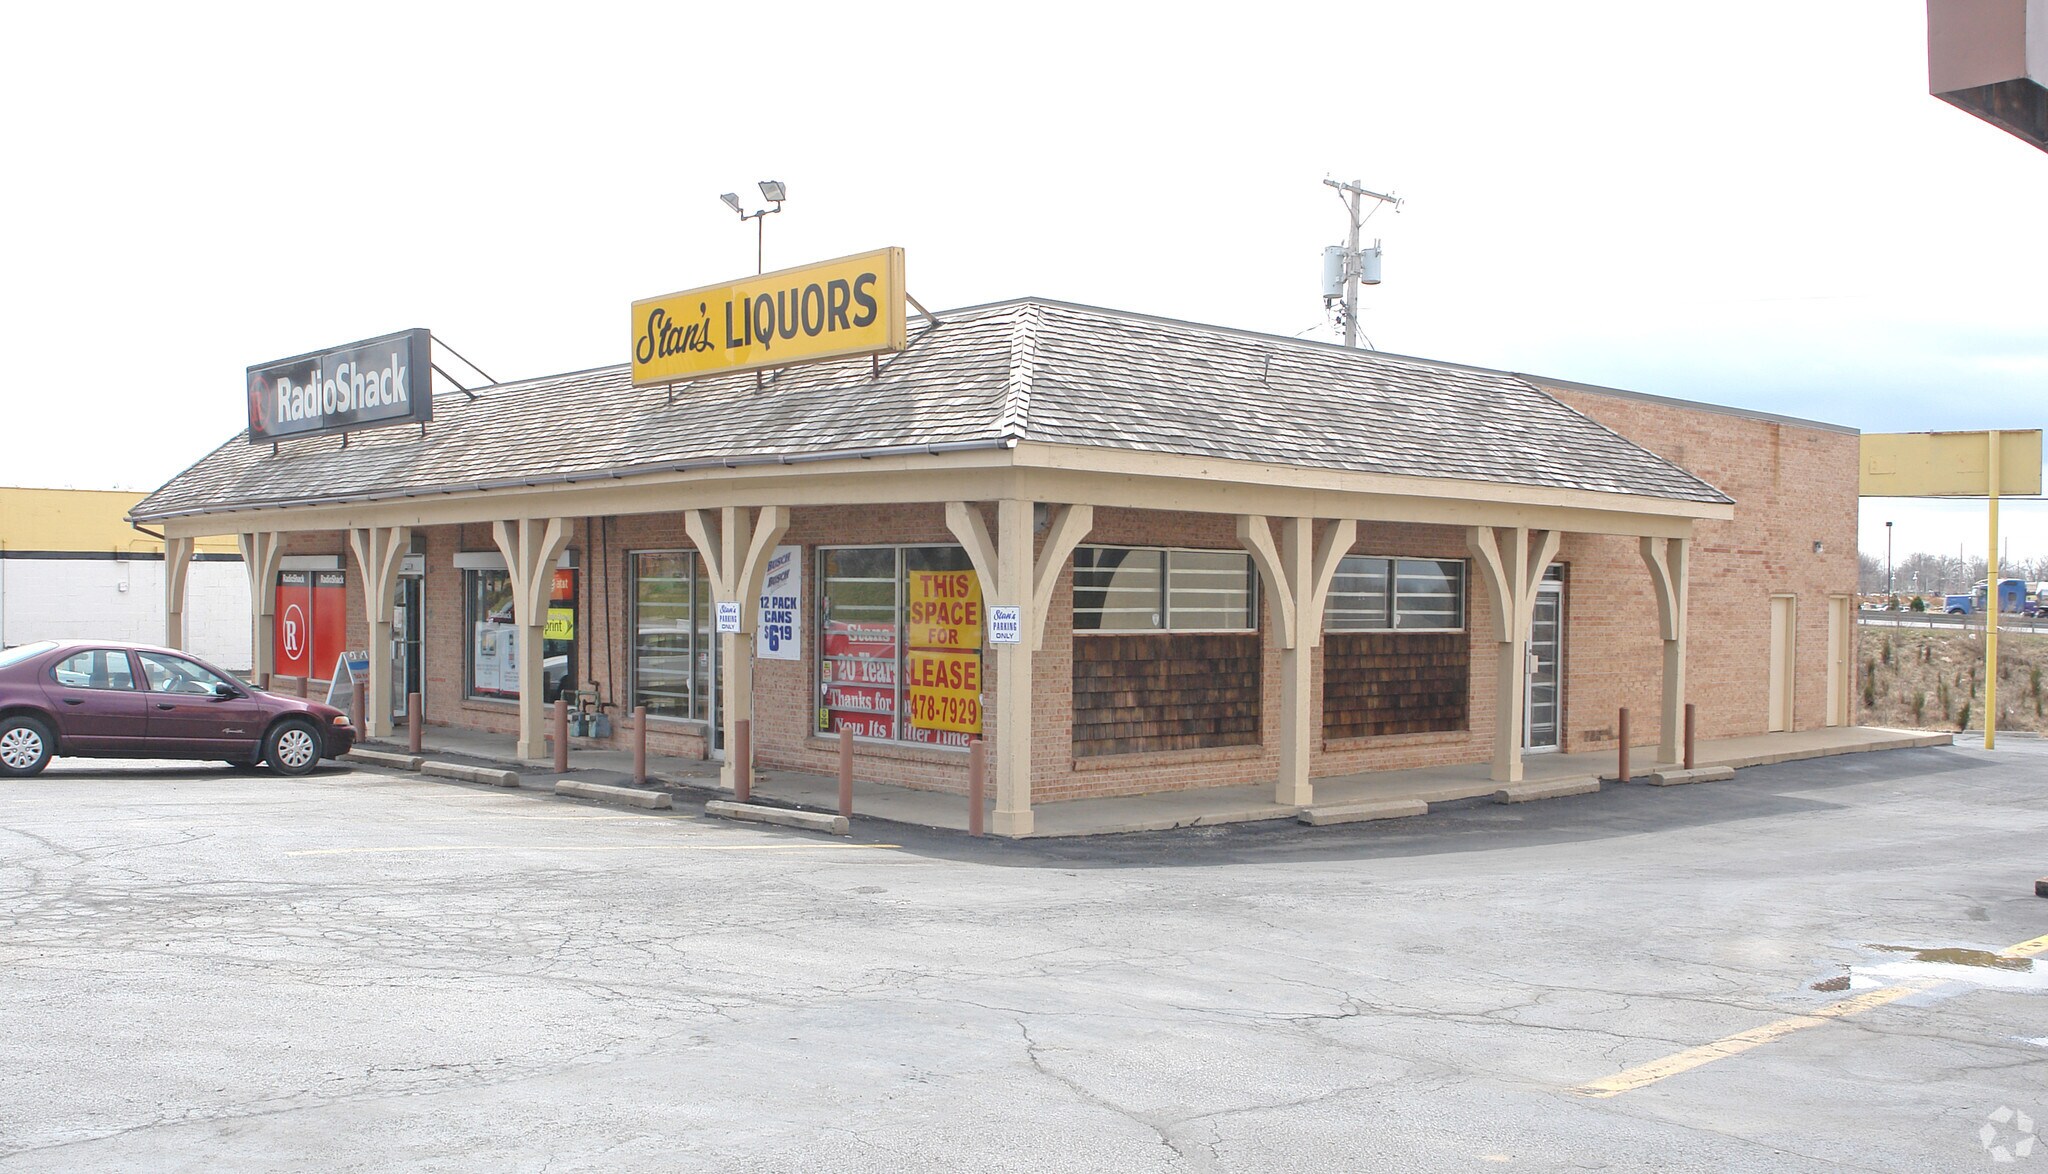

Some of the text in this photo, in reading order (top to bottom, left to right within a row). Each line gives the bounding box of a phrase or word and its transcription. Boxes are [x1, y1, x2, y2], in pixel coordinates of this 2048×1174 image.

[636, 272, 878, 364] Stan's LIQUORS
[277, 353, 407, 423] RadioShack
[767, 552, 791, 572] BUSCH
[320, 574, 344, 584] RadioShack
[767, 569, 790, 588] BUSCH
[920, 575, 969, 598] THIS
[760, 597, 797, 609] 12 PACK
[912, 602, 977, 625] SPACE
[764, 611, 792, 624] CANS
[994, 610, 1016, 620] Stan's
[285, 621, 297, 651] R
[545, 619, 562, 635] print
[848, 624, 890, 642] Stans
[928, 629, 959, 644] FOR
[993, 622, 1017, 631] PARKING
[837, 653, 856, 681] 20
[910, 658, 977, 690] LEASE
[829, 689, 872, 711] Thanks
[875, 693, 892, 712] for
[911, 694, 977, 725] 478-7929
[868, 720, 887, 738] Its
[891, 722, 930, 743] iller
